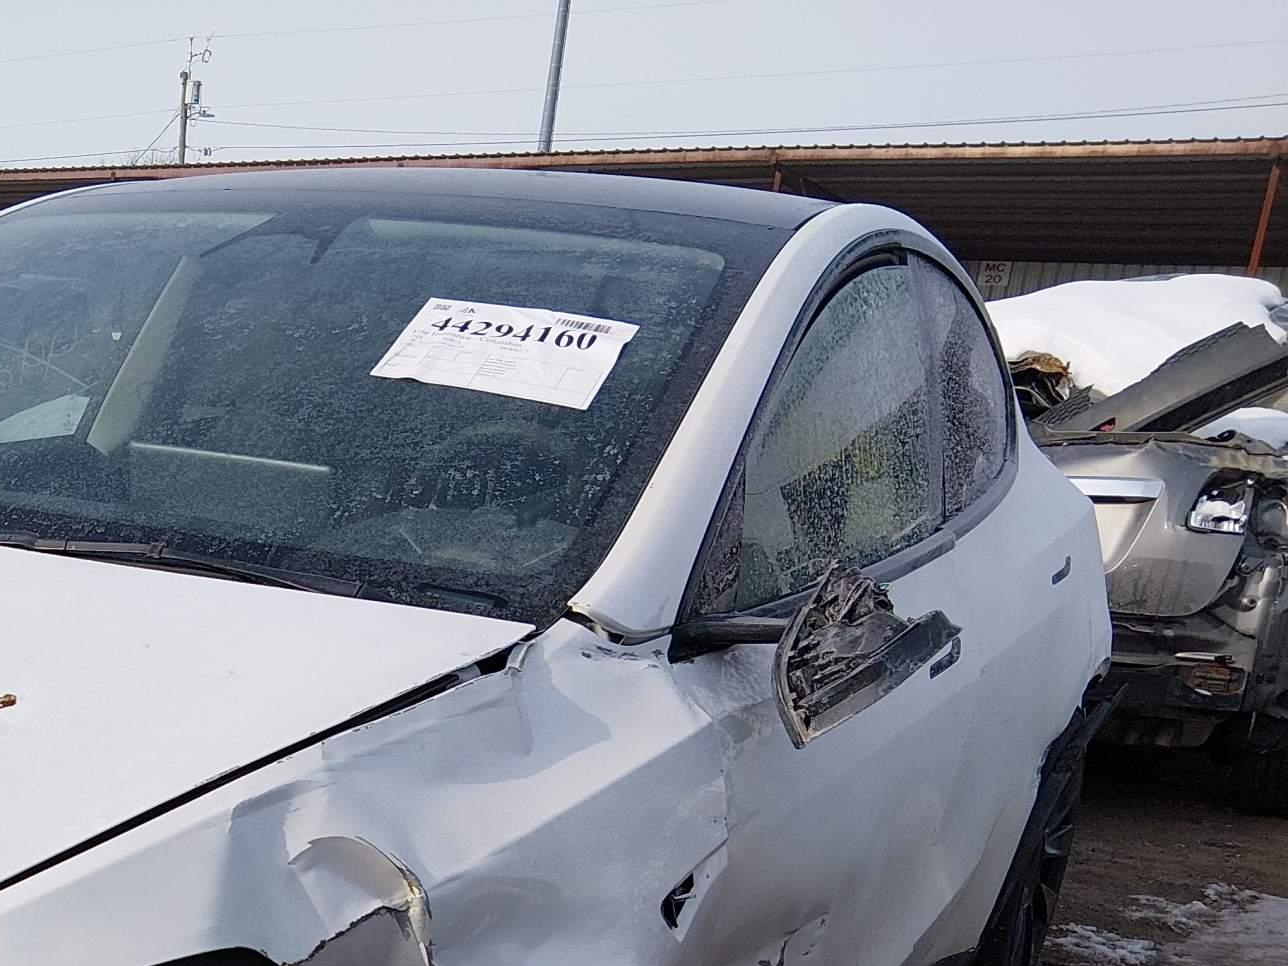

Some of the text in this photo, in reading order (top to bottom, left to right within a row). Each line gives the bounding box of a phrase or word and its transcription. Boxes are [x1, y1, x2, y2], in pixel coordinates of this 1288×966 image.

[984, 263, 1007, 273] MC
[984, 274, 1002, 284] 20
[431, 316, 598, 351] 44294160
